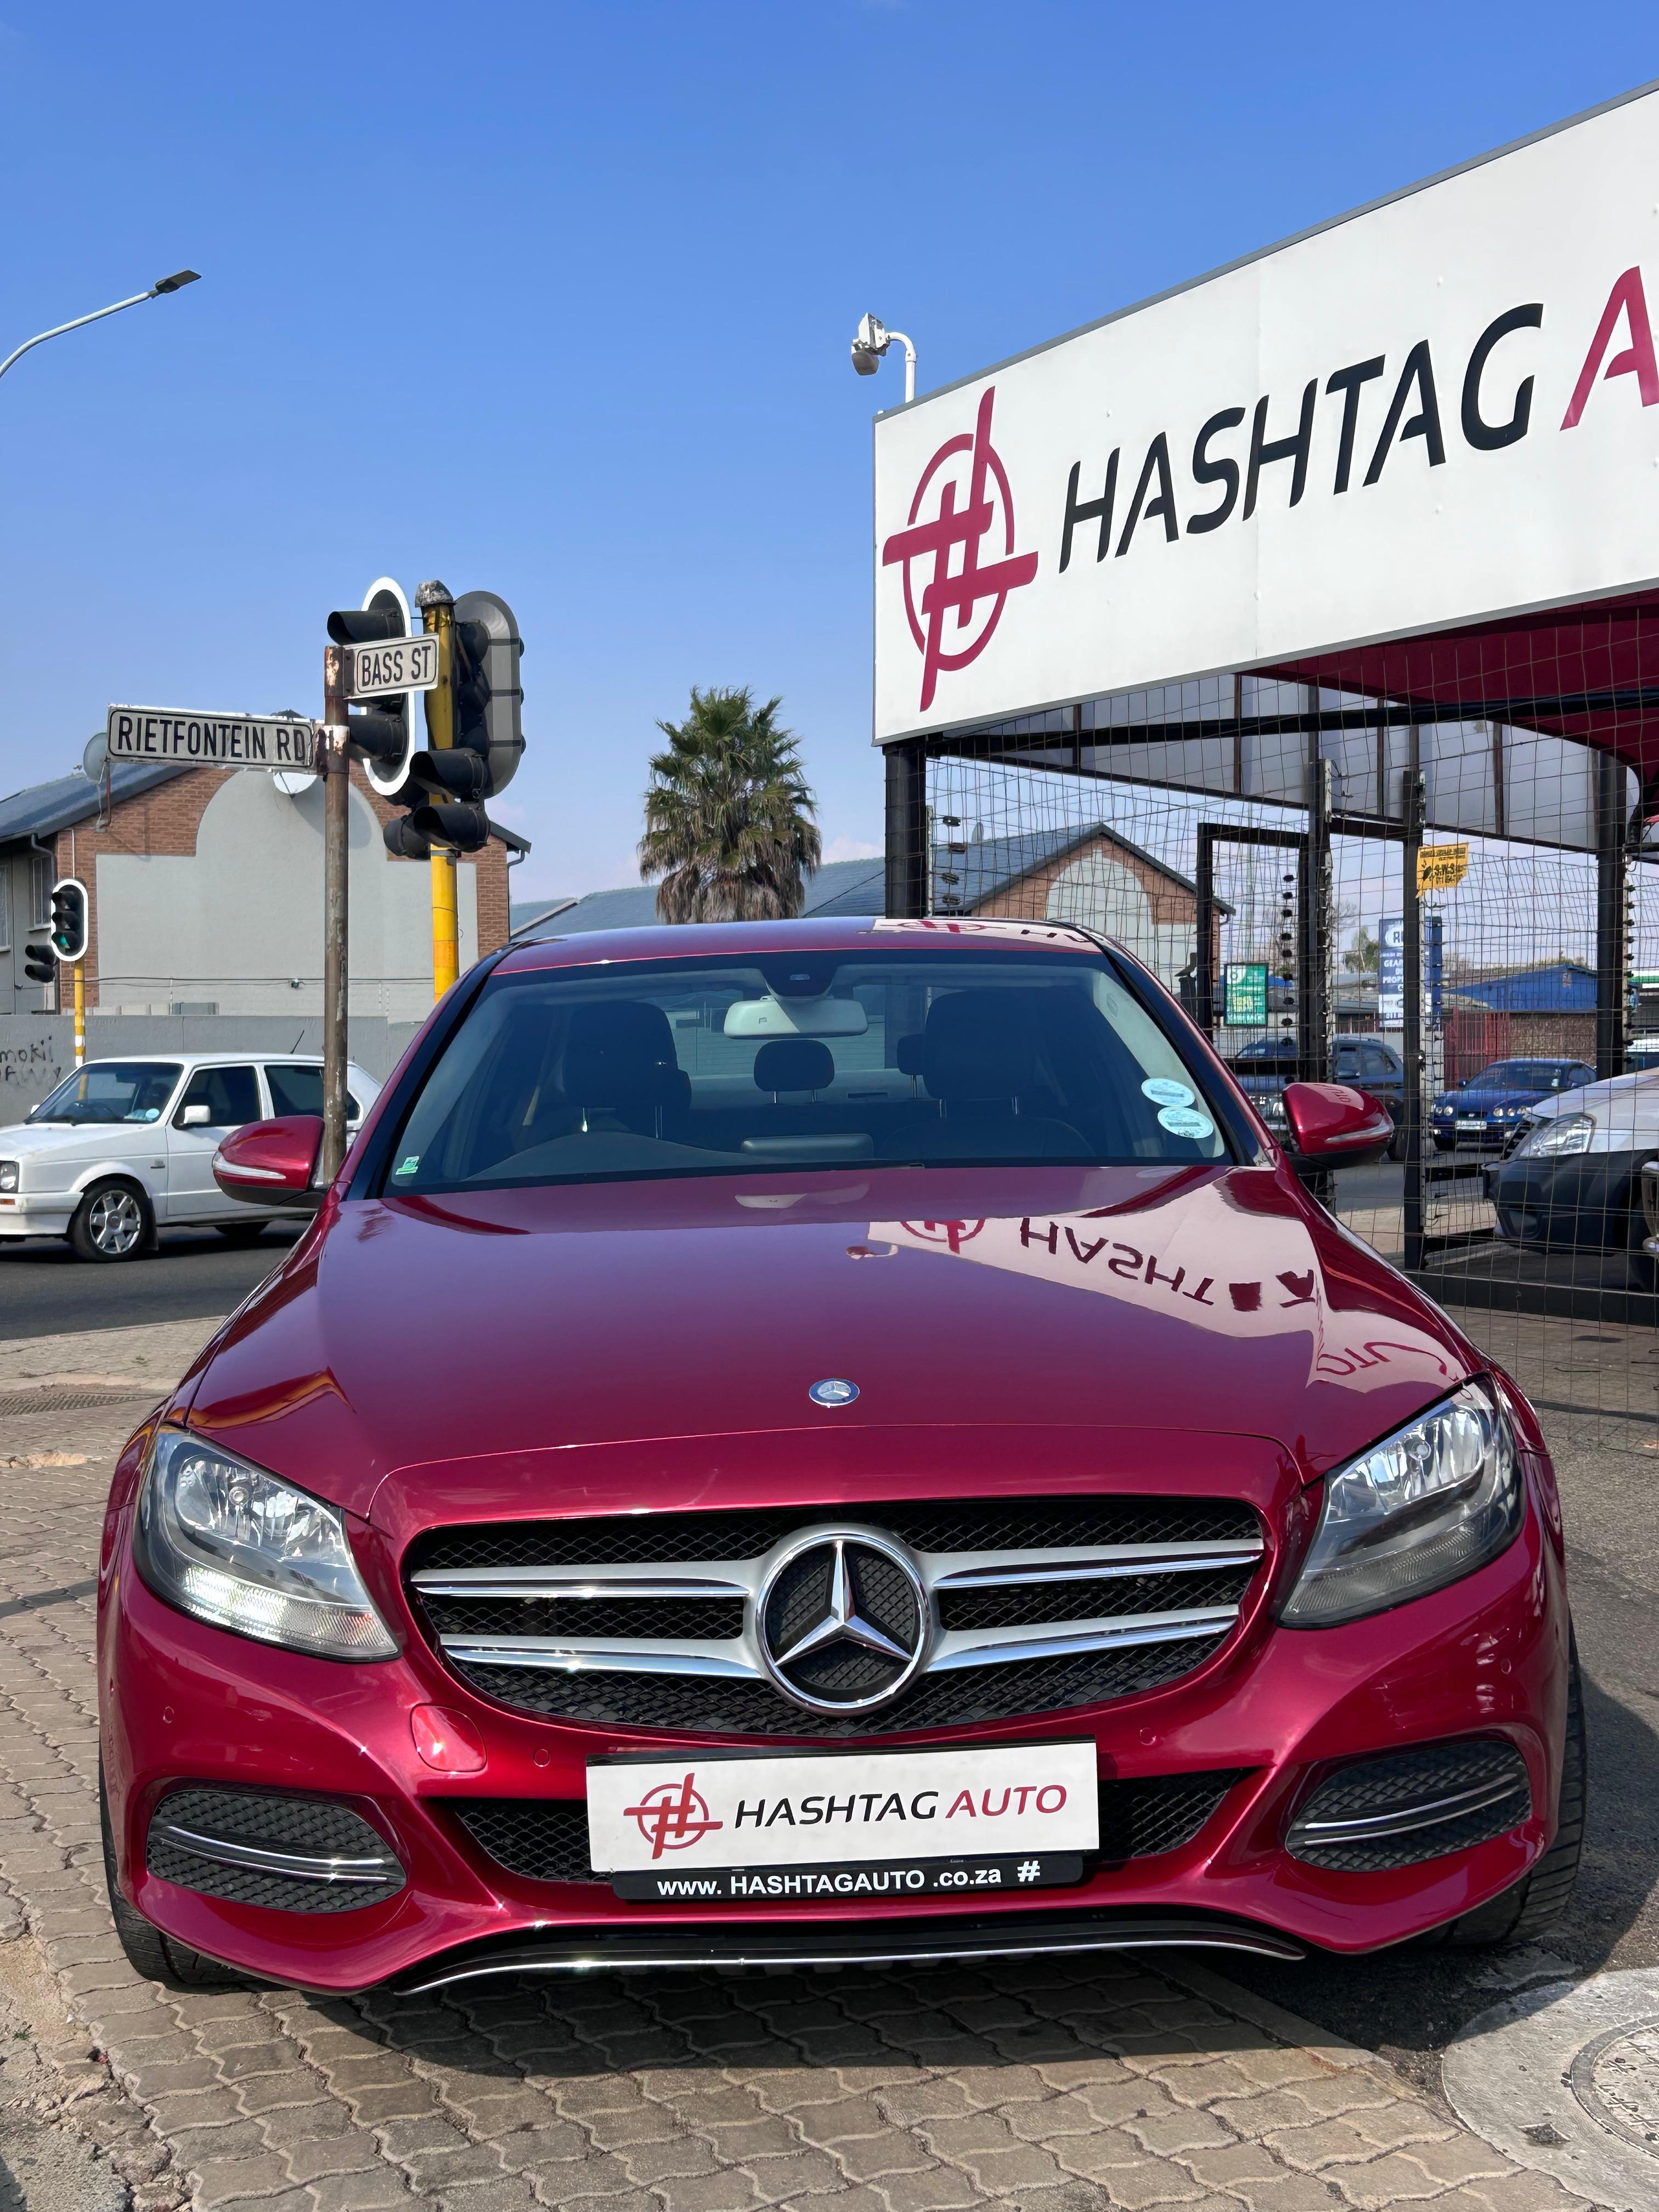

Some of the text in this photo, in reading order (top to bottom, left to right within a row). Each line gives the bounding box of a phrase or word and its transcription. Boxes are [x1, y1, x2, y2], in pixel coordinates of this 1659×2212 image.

[1058, 302, 1544, 574] HASHTAG
[362, 646, 431, 687] BASS ST
[117, 715, 306, 761] RIETFONTEIN RD
[735, 1784, 1068, 1829] HASHTAG AUTO
[657, 1881, 722, 1896] www.
[730, 1869, 926, 1895] HASHTAGAUTO
[933, 1868, 1002, 1887] .co.za
